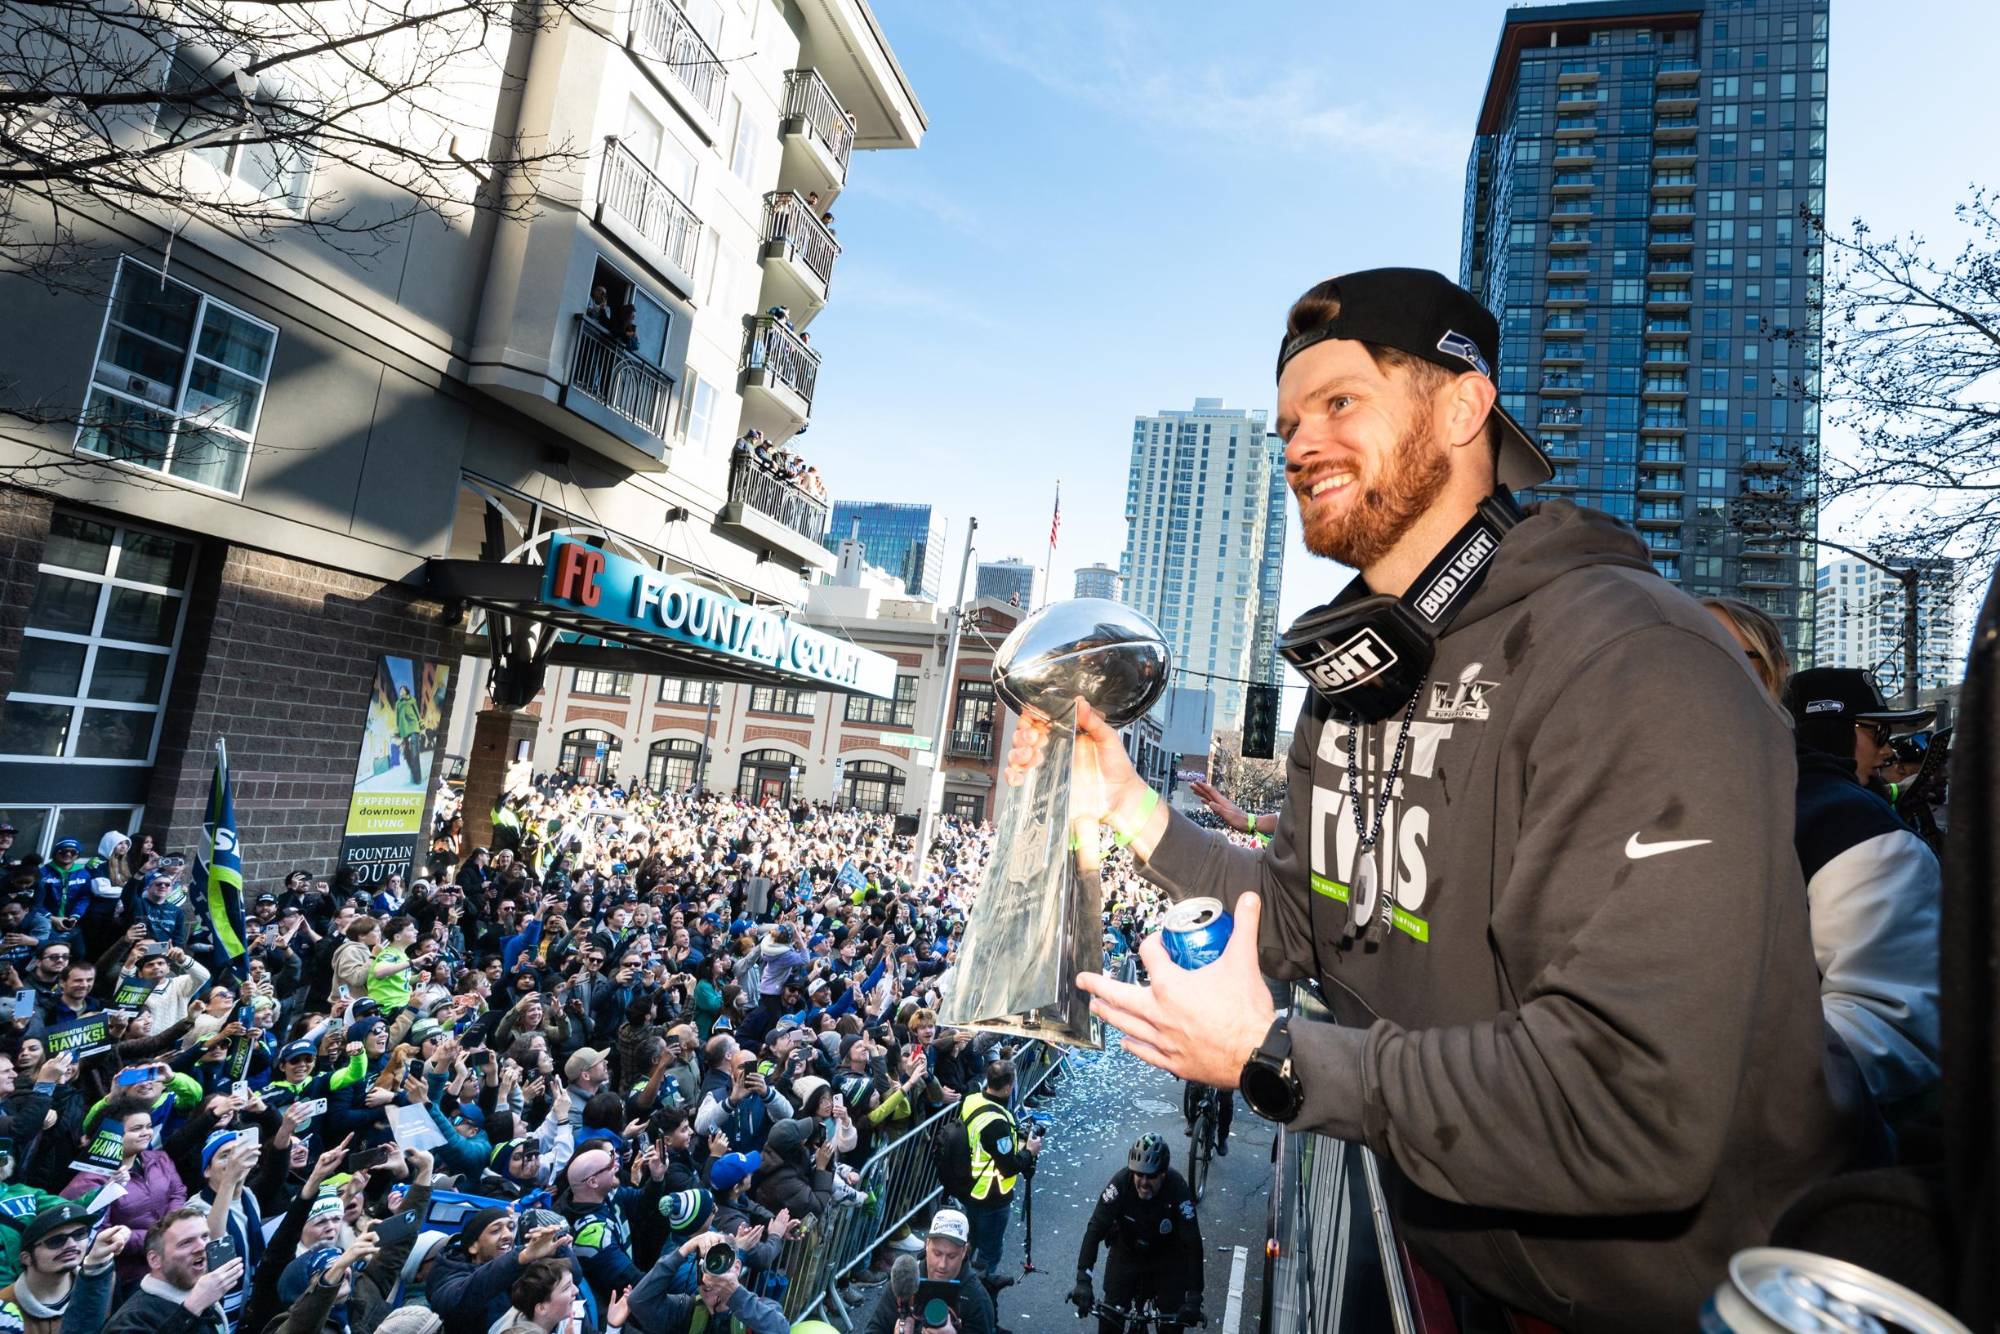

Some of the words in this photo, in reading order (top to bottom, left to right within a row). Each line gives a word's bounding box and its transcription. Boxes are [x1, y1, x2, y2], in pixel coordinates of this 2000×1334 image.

[554, 542, 605, 608] FC
[1420, 576, 1457, 616] BUD
[1448, 533, 1494, 581] LIGHT
[634, 573, 790, 666] FOUNTAIN
[791, 632, 865, 685] COURT
[1306, 638, 1381, 689] IGHT
[356, 796, 421, 807] EXPERIENCE
[359, 807, 415, 816] downtown
[367, 818, 405, 829] LIVING
[347, 846, 414, 861] FOUNTAIN
[356, 862, 410, 884] OURT
[49, 1029, 106, 1053] HAWKS!
